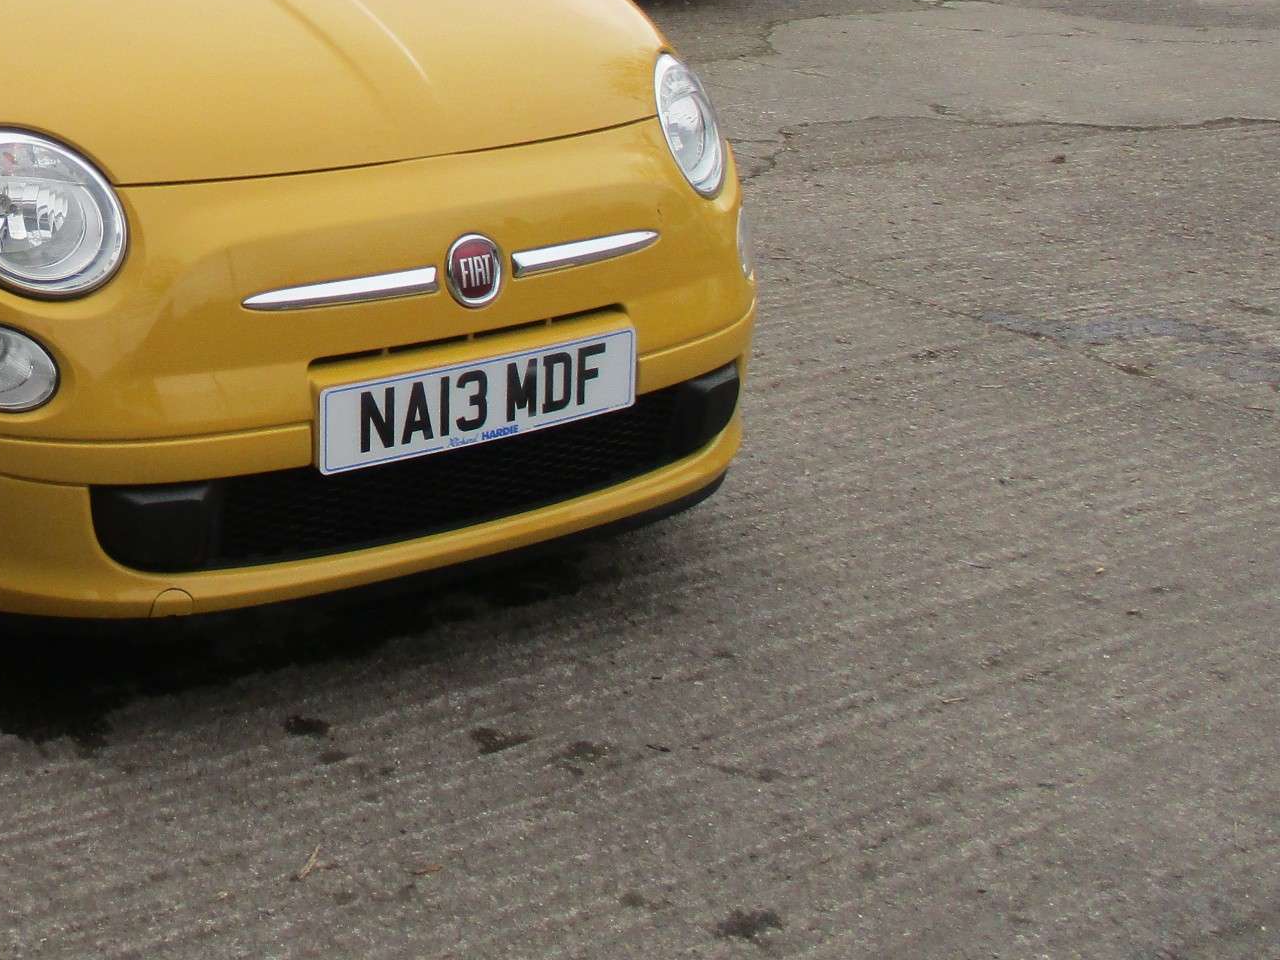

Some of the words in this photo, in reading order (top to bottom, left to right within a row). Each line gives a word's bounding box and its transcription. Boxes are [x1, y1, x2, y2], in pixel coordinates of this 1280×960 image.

[459, 252, 493, 290] FIAT
[359, 369, 489, 454] NA13
[506, 342, 607, 423] MDF
